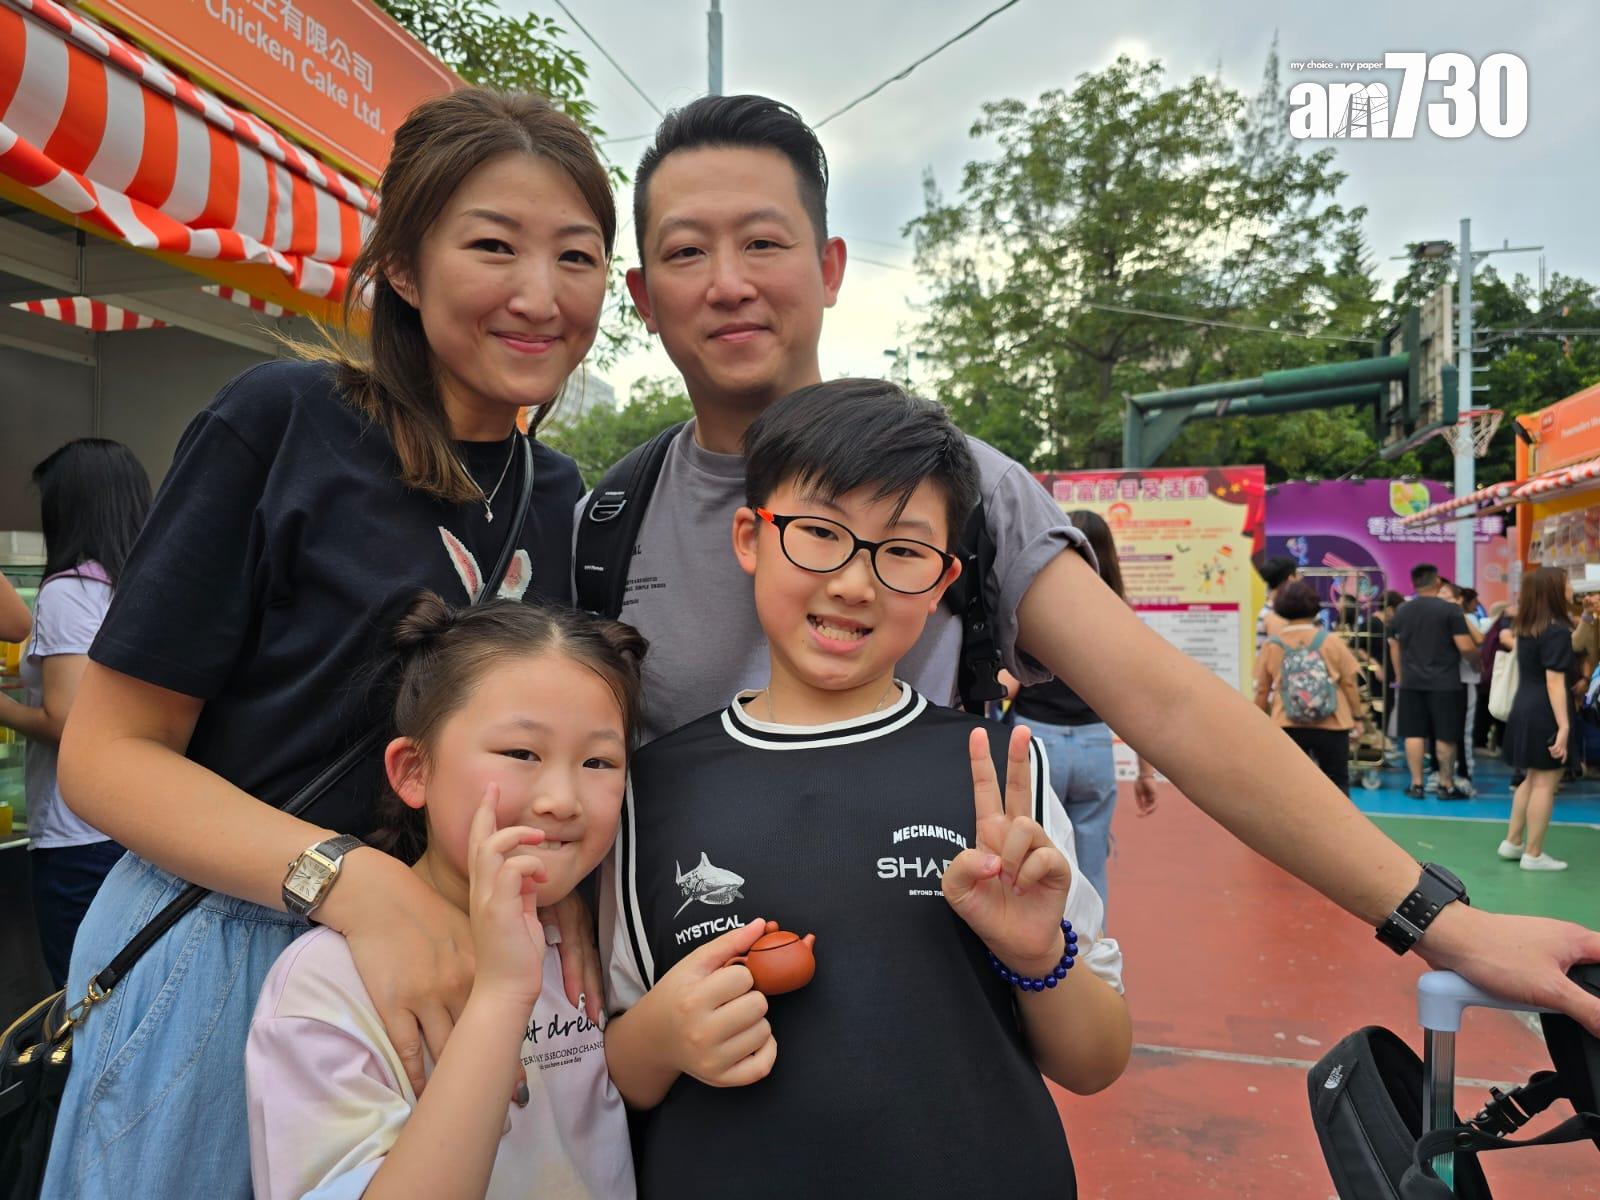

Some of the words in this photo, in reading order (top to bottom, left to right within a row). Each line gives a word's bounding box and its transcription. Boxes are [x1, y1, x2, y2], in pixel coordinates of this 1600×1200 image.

[205, 0, 296, 72] Chicken
[301, 58, 349, 109] Cake
[353, 93, 386, 136] Ltd.
[1052, 476, 1209, 501] 豐富節目及活動
[892, 824, 969, 850] MECHANICAL
[675, 914, 744, 944] MYSTICAL
[549, 1047, 578, 1060] SECOND
